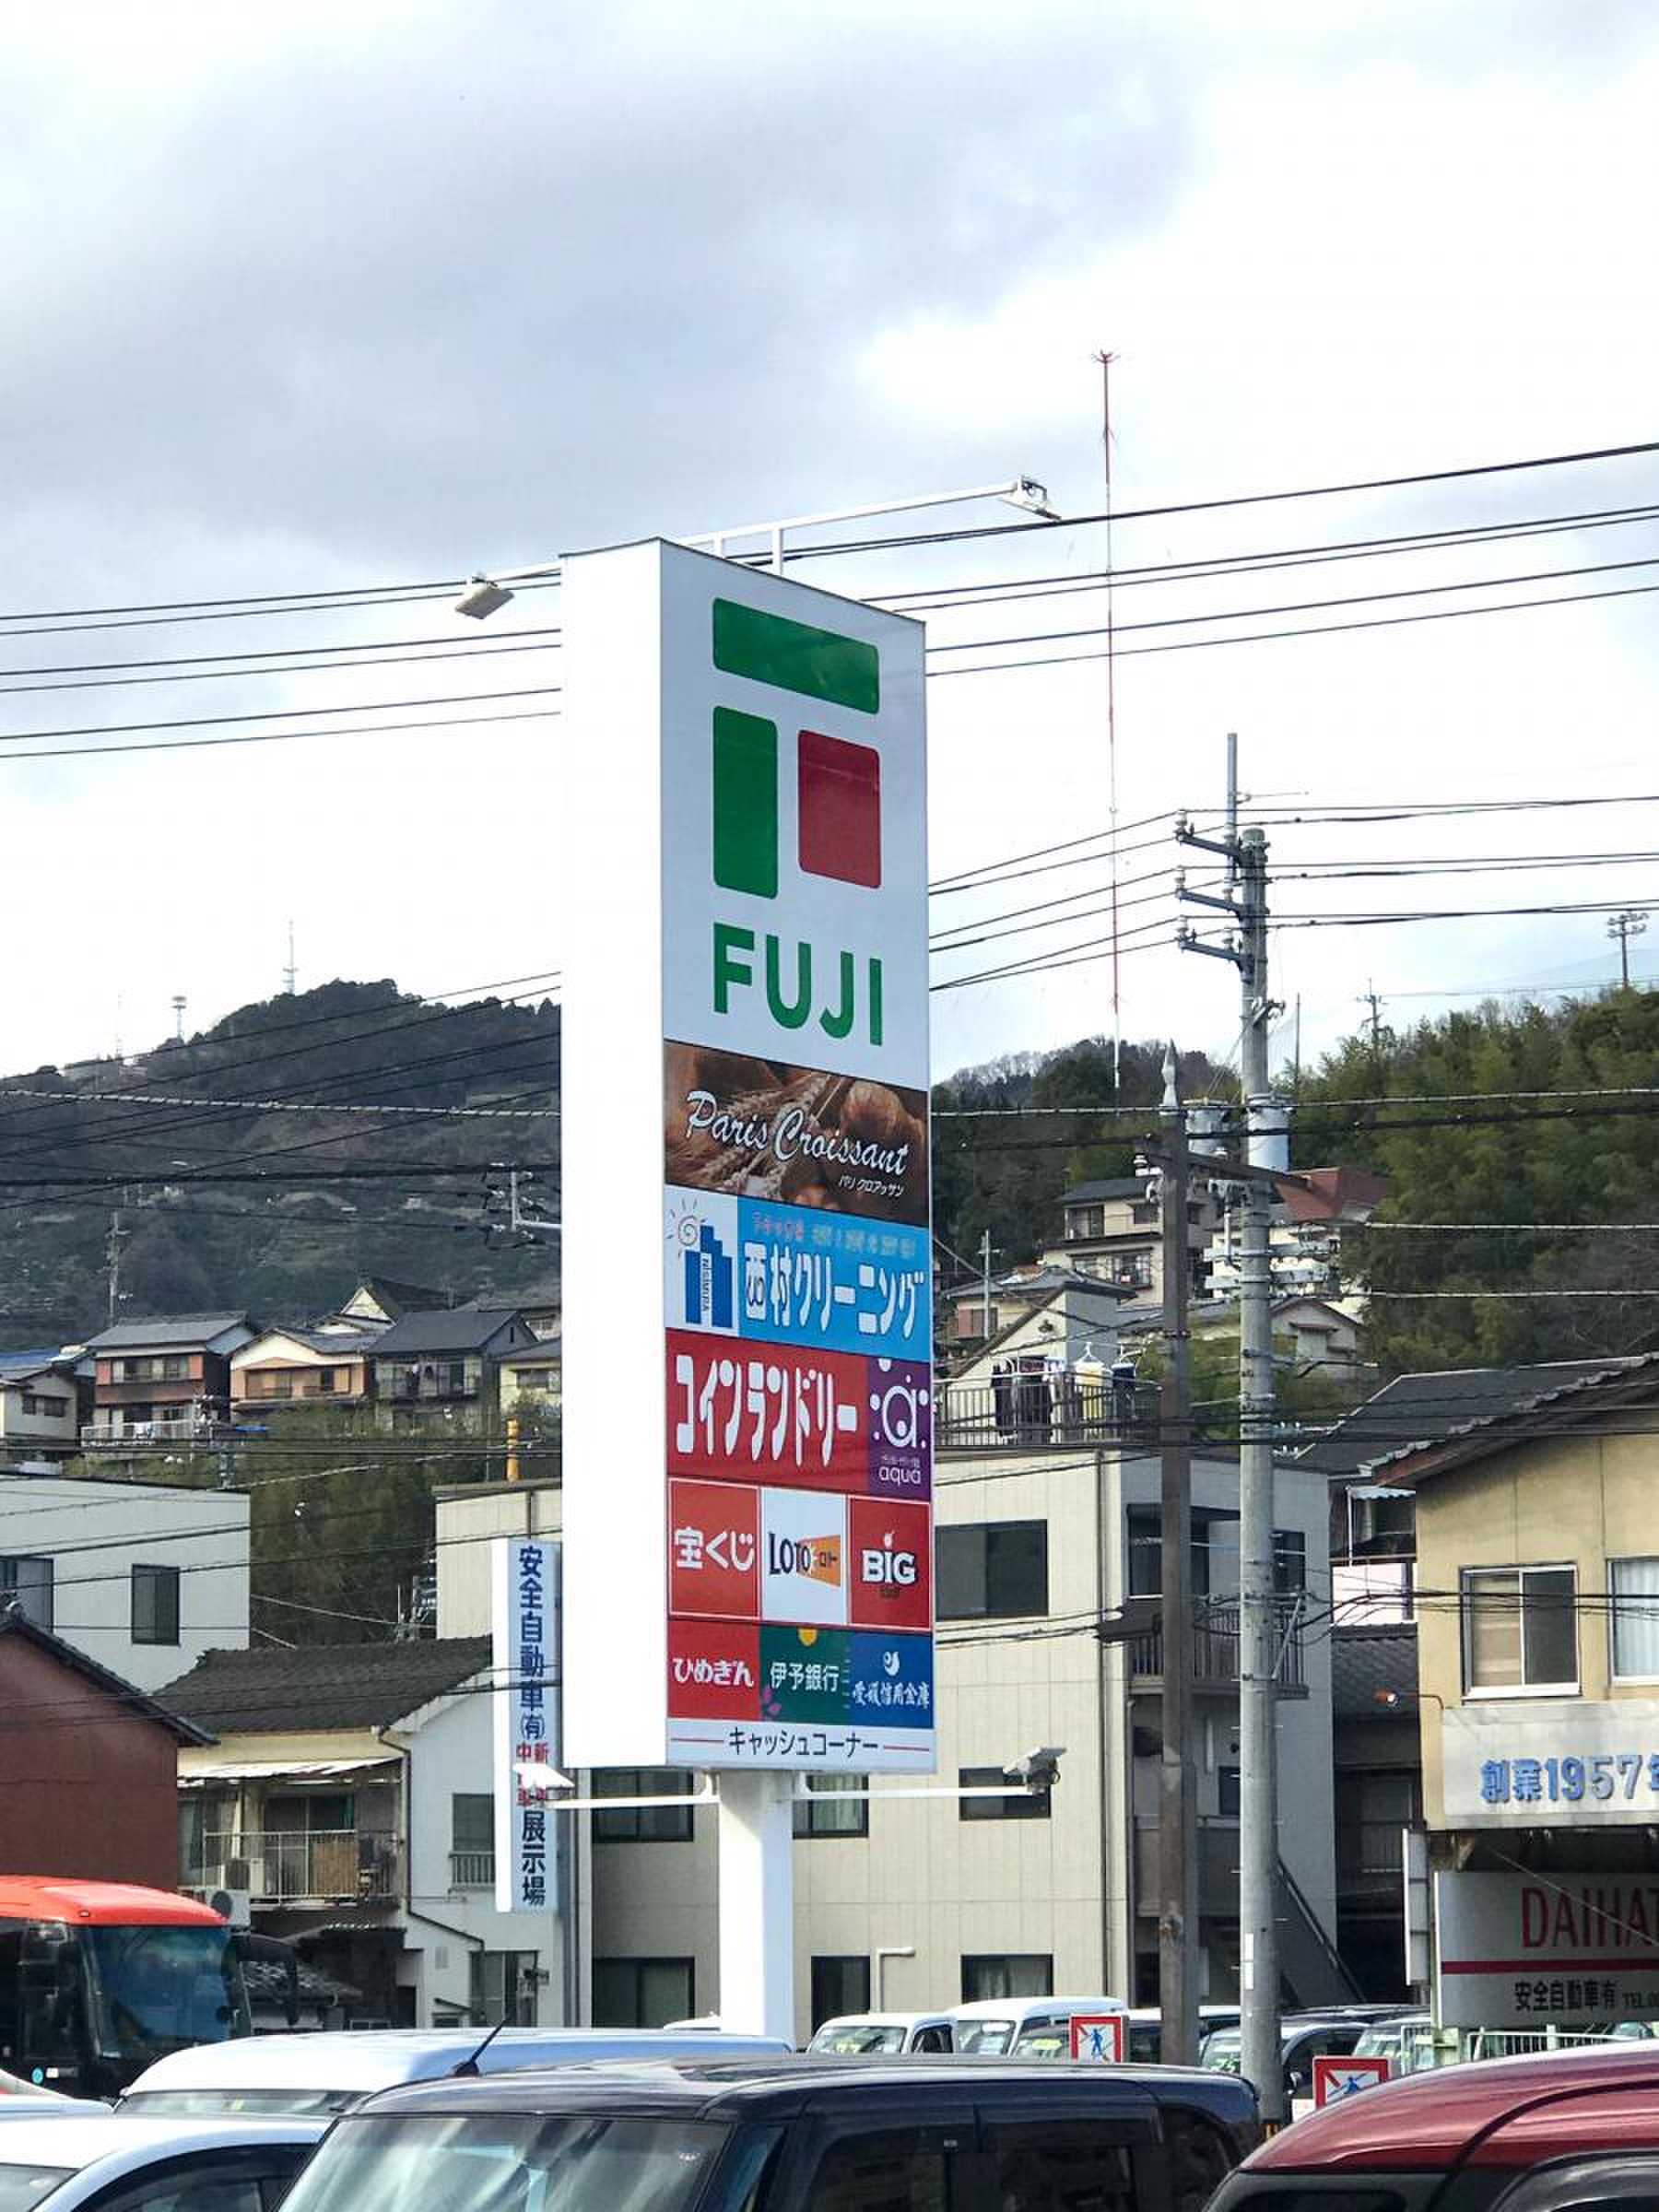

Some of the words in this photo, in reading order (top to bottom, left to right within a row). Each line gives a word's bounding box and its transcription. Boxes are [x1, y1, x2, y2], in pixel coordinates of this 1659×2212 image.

[713, 922, 883, 1047] FUJI
[685, 1090, 768, 1150] Paris
[774, 1108, 910, 1176] Croissant
[744, 1241, 925, 1339] 西村クリーニング
[676, 1355, 857, 1467] コインランドリー
[878, 1465, 921, 1487] aqua
[674, 1526, 755, 1572] 宝くじ
[768, 1531, 812, 1575] LOTO
[862, 1548, 917, 1585] BIG
[771, 1662, 840, 1692] 伊予銀行
[729, 1726, 878, 1758] キャッシュコーナー
[522, 1810, 546, 1907] 展示場
